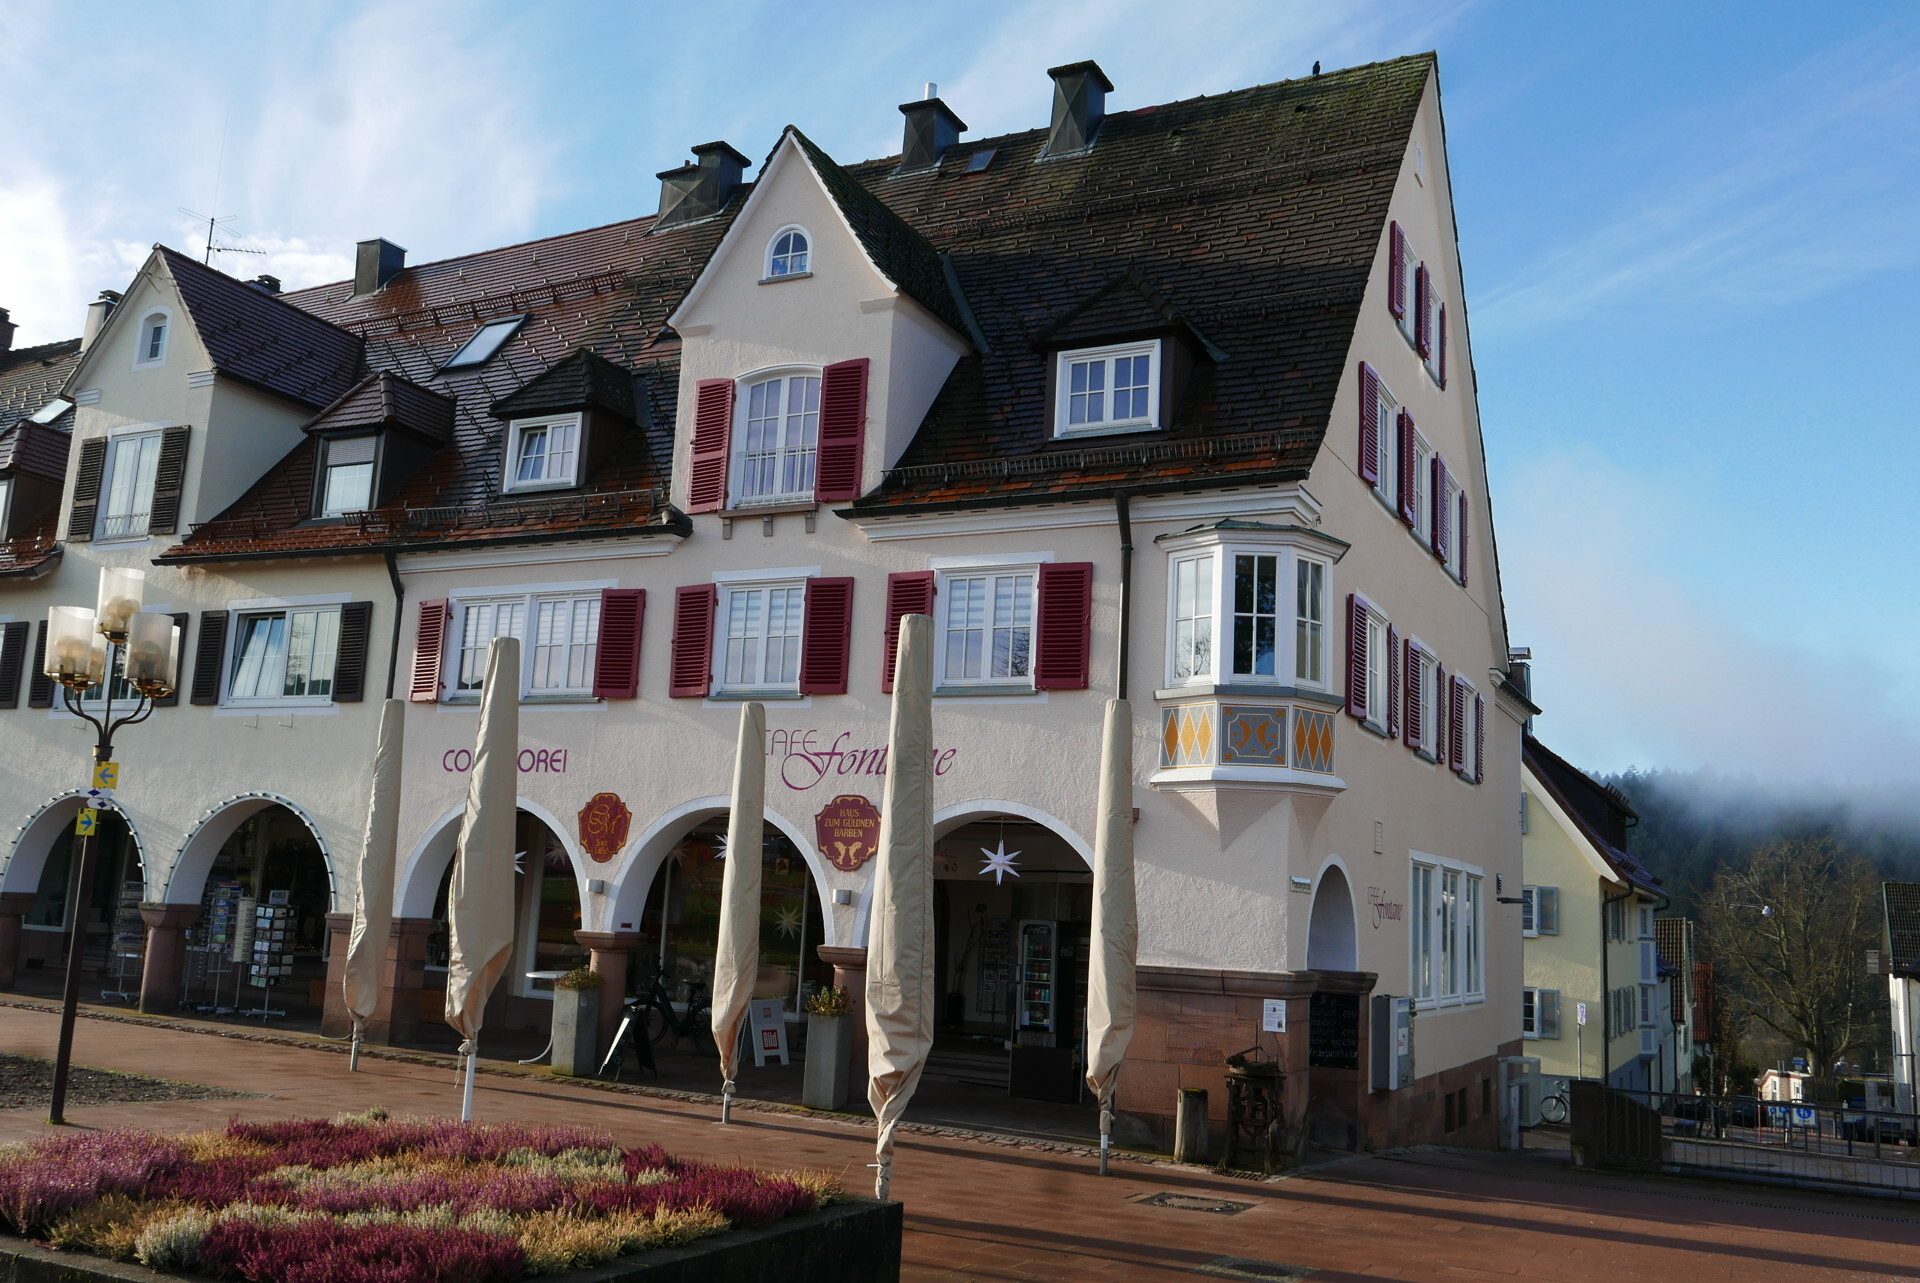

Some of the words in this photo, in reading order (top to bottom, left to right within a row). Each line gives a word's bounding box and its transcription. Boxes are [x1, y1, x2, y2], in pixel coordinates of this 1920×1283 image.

[442, 748, 568, 773] COOREI
[781, 731, 957, 791] fonte
[839, 808, 859, 817] HAUS
[824, 818, 841, 828] ZUM
[842, 817, 875, 828] GÜLDNEN
[834, 828, 863, 838] BARBEN
